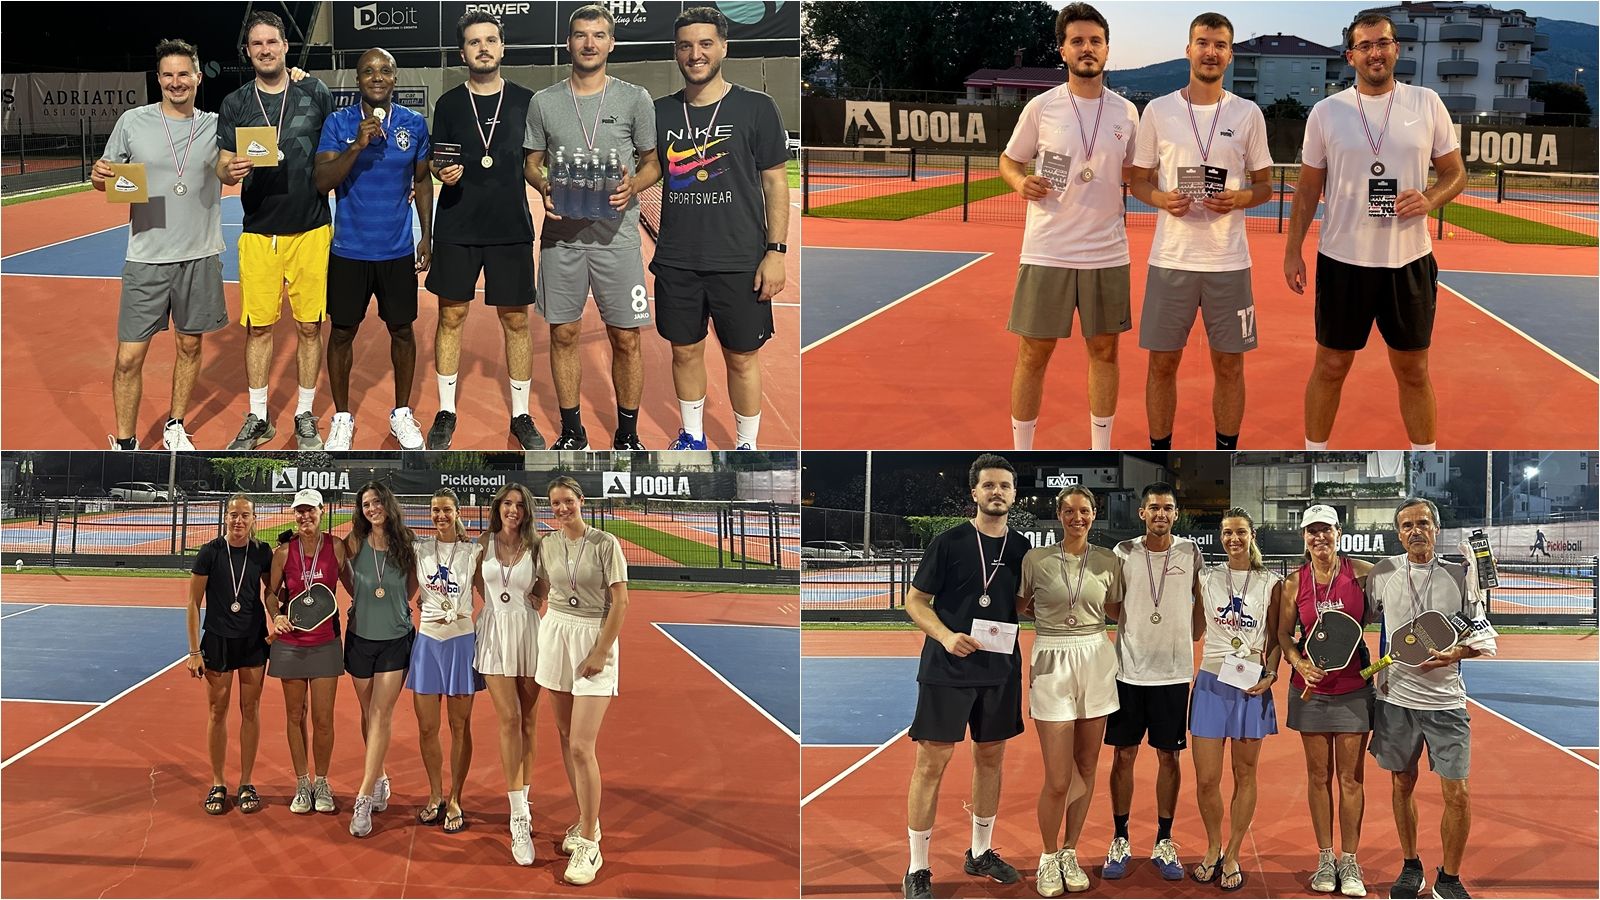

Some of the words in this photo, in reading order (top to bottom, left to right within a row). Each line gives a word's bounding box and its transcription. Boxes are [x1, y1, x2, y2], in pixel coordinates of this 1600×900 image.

[360, 7, 418, 26] Dobit
[43, 90, 136, 105] ADRIATIC
[43, 108, 127, 116] OSIGURAN
[666, 124, 734, 141] NIKE
[896, 109, 986, 144] JOOLA
[1466, 131, 1558, 165] JOOLA
[669, 191, 732, 205] SPORTSWEAR
[631, 284, 648, 313] 8
[1237, 304, 1255, 339] 17
[300, 471, 350, 490] JOOLA
[440, 474, 506, 486] Pickleball
[633, 476, 691, 496] JOOLA
[1546, 541, 1582, 552] Pickleball
